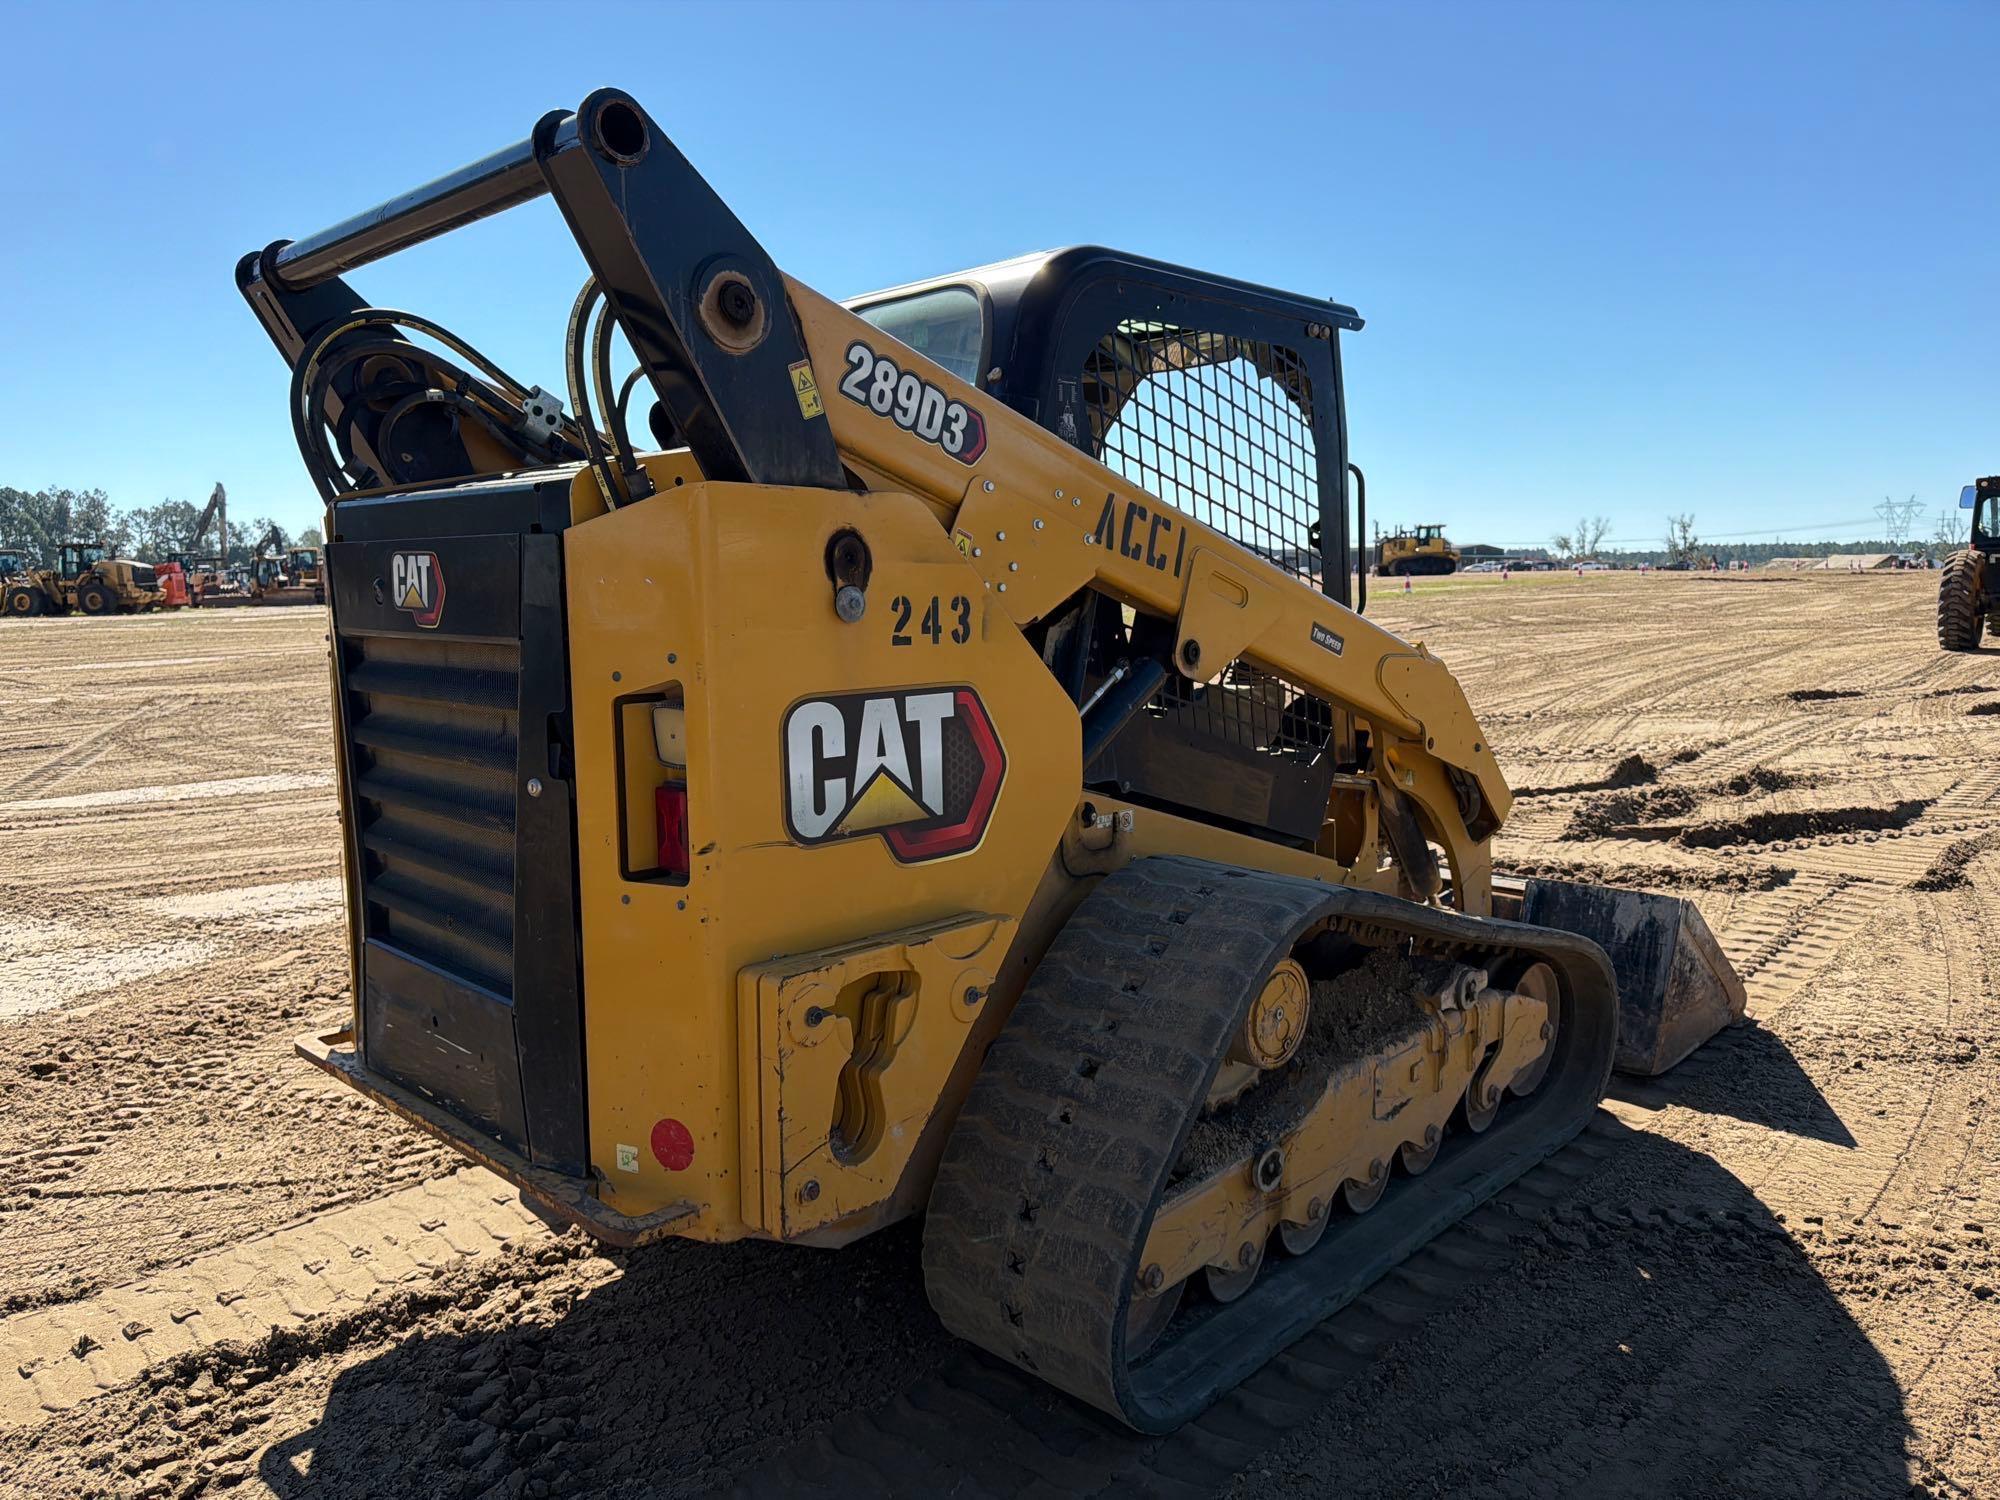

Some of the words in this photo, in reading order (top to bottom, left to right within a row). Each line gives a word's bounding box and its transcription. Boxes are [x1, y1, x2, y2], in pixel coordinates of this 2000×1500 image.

[841, 345, 968, 454] 289D3
[392, 554, 430, 608] CAT
[891, 595, 971, 646] 243
[787, 692, 955, 838] CAT
